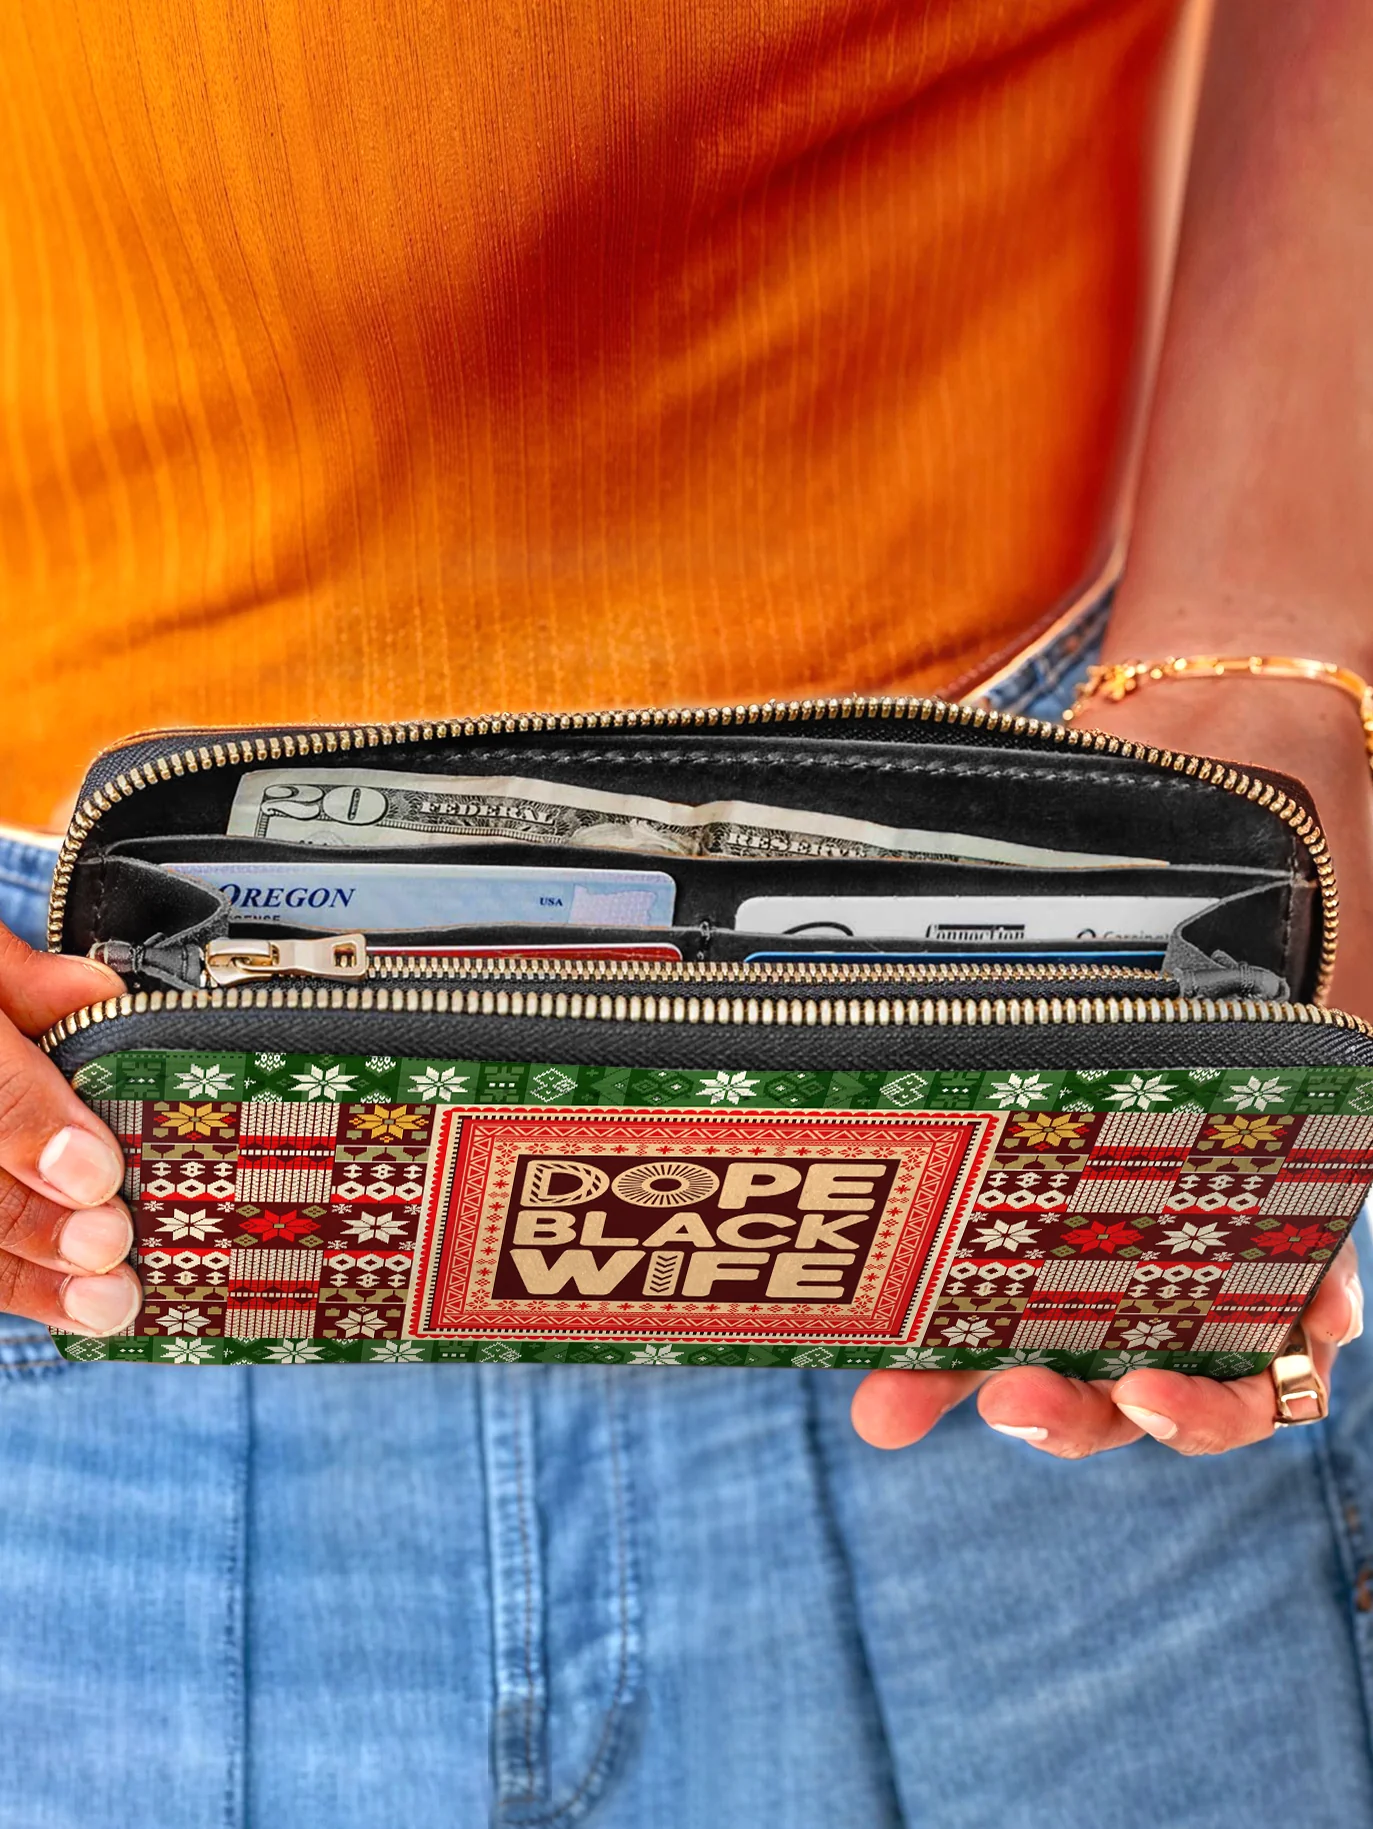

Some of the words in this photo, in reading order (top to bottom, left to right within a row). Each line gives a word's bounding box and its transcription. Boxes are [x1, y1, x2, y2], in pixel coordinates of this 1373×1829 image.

[261, 784, 389, 826] 20
[420, 802, 554, 825] FEDERAL
[219, 883, 356, 908] OREGON
[540, 897, 563, 906] USA
[520, 1160, 887, 1211] DOPE
[512, 1210, 870, 1250] BLACK
[509, 1249, 856, 1299] WIFE
